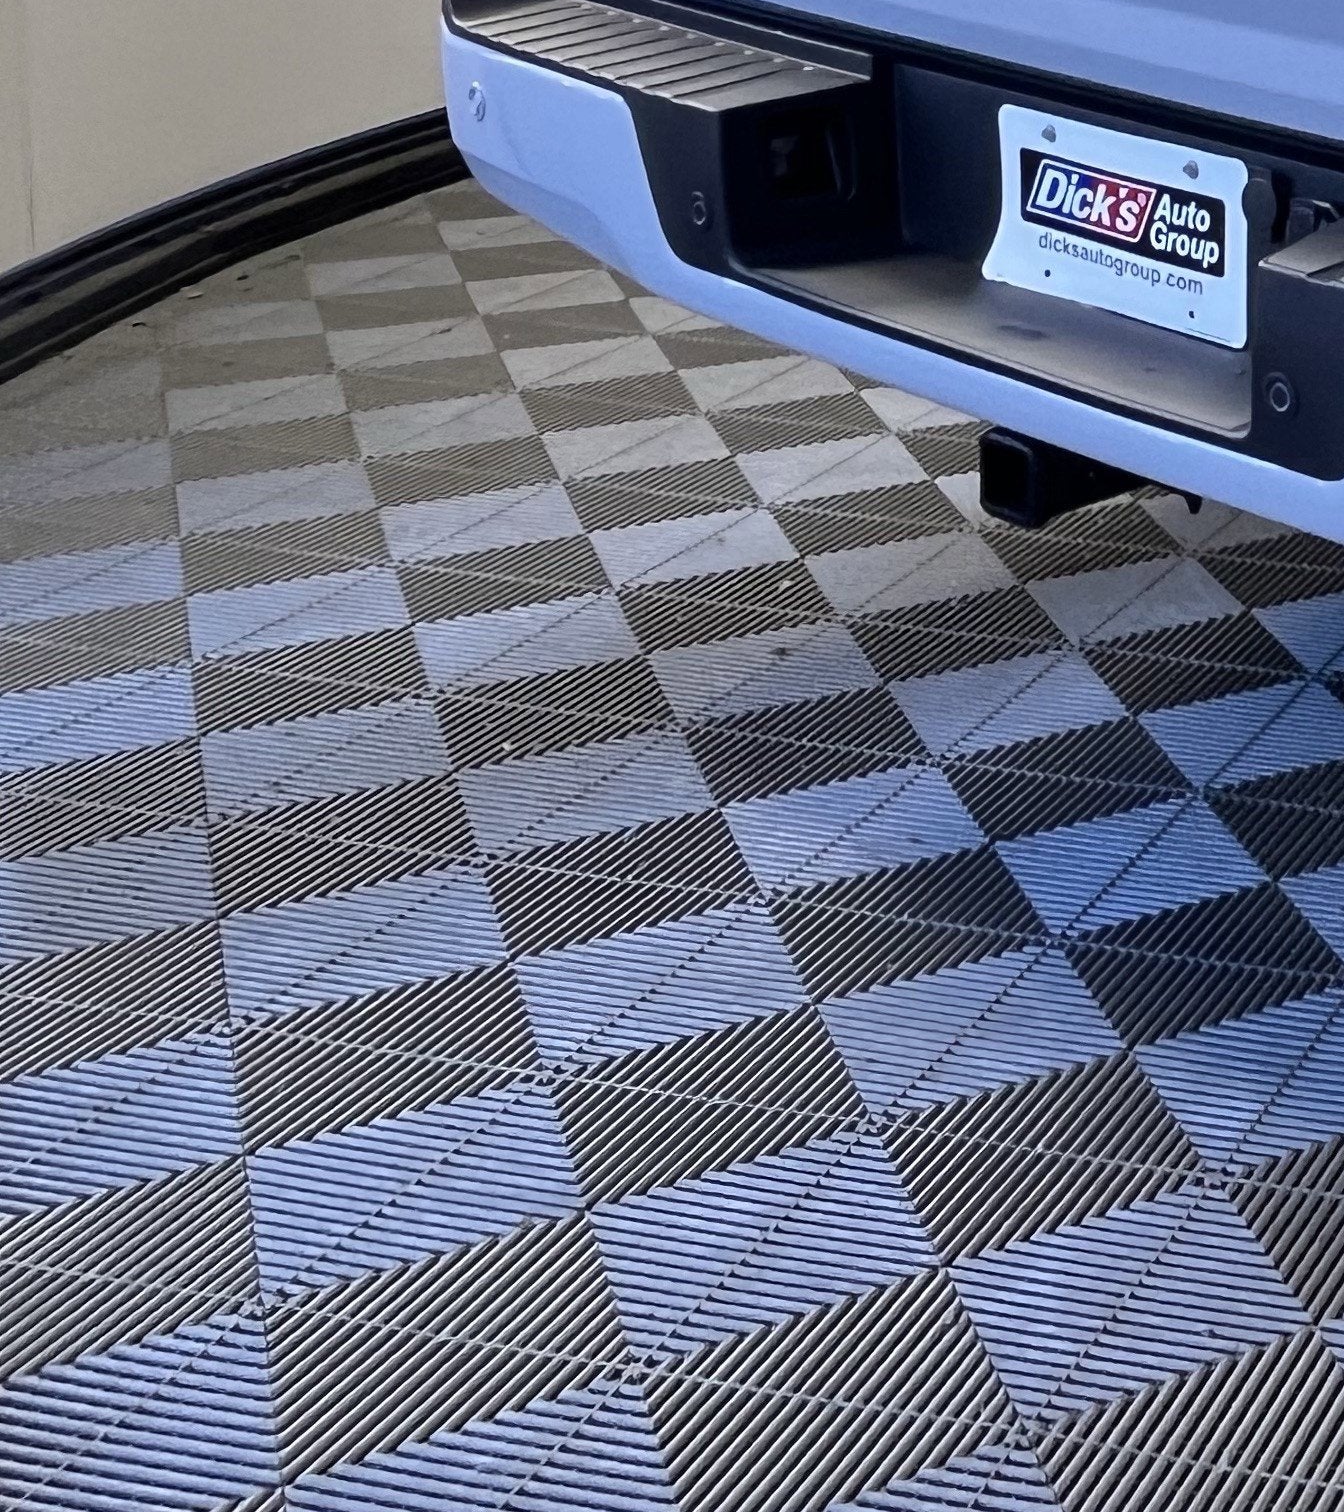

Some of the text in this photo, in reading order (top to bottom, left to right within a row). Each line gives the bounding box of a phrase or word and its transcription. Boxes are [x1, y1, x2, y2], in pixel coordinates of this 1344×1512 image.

[1035, 167, 1147, 233] Dick's
[1154, 193, 1211, 233] Auto
[1038, 233, 1203, 295] dicksautogroupcom
[1149, 220, 1220, 269] Group
